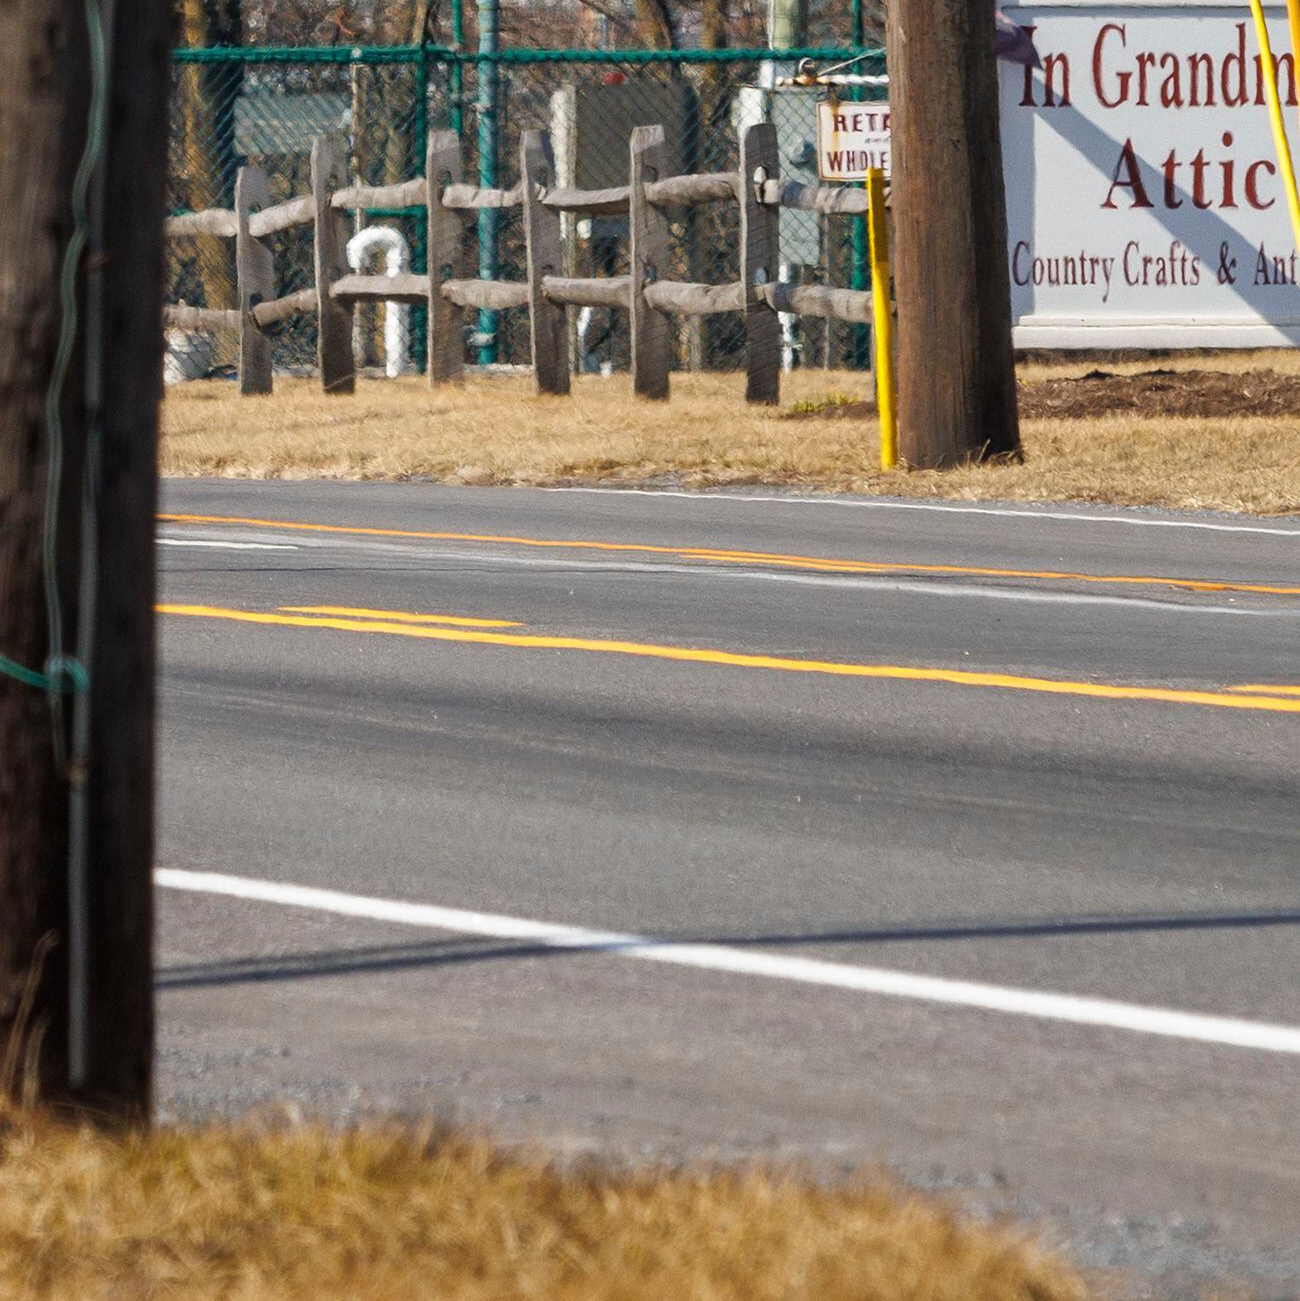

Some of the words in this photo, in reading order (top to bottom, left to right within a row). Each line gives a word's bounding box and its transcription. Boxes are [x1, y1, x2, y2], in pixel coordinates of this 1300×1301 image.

[1018, 24, 1072, 107] In
[1100, 131, 1276, 210] Attic
[1012, 240, 1115, 303] Country
[1123, 240, 1200, 287] Crafts
[1217, 240, 1238, 286] &
